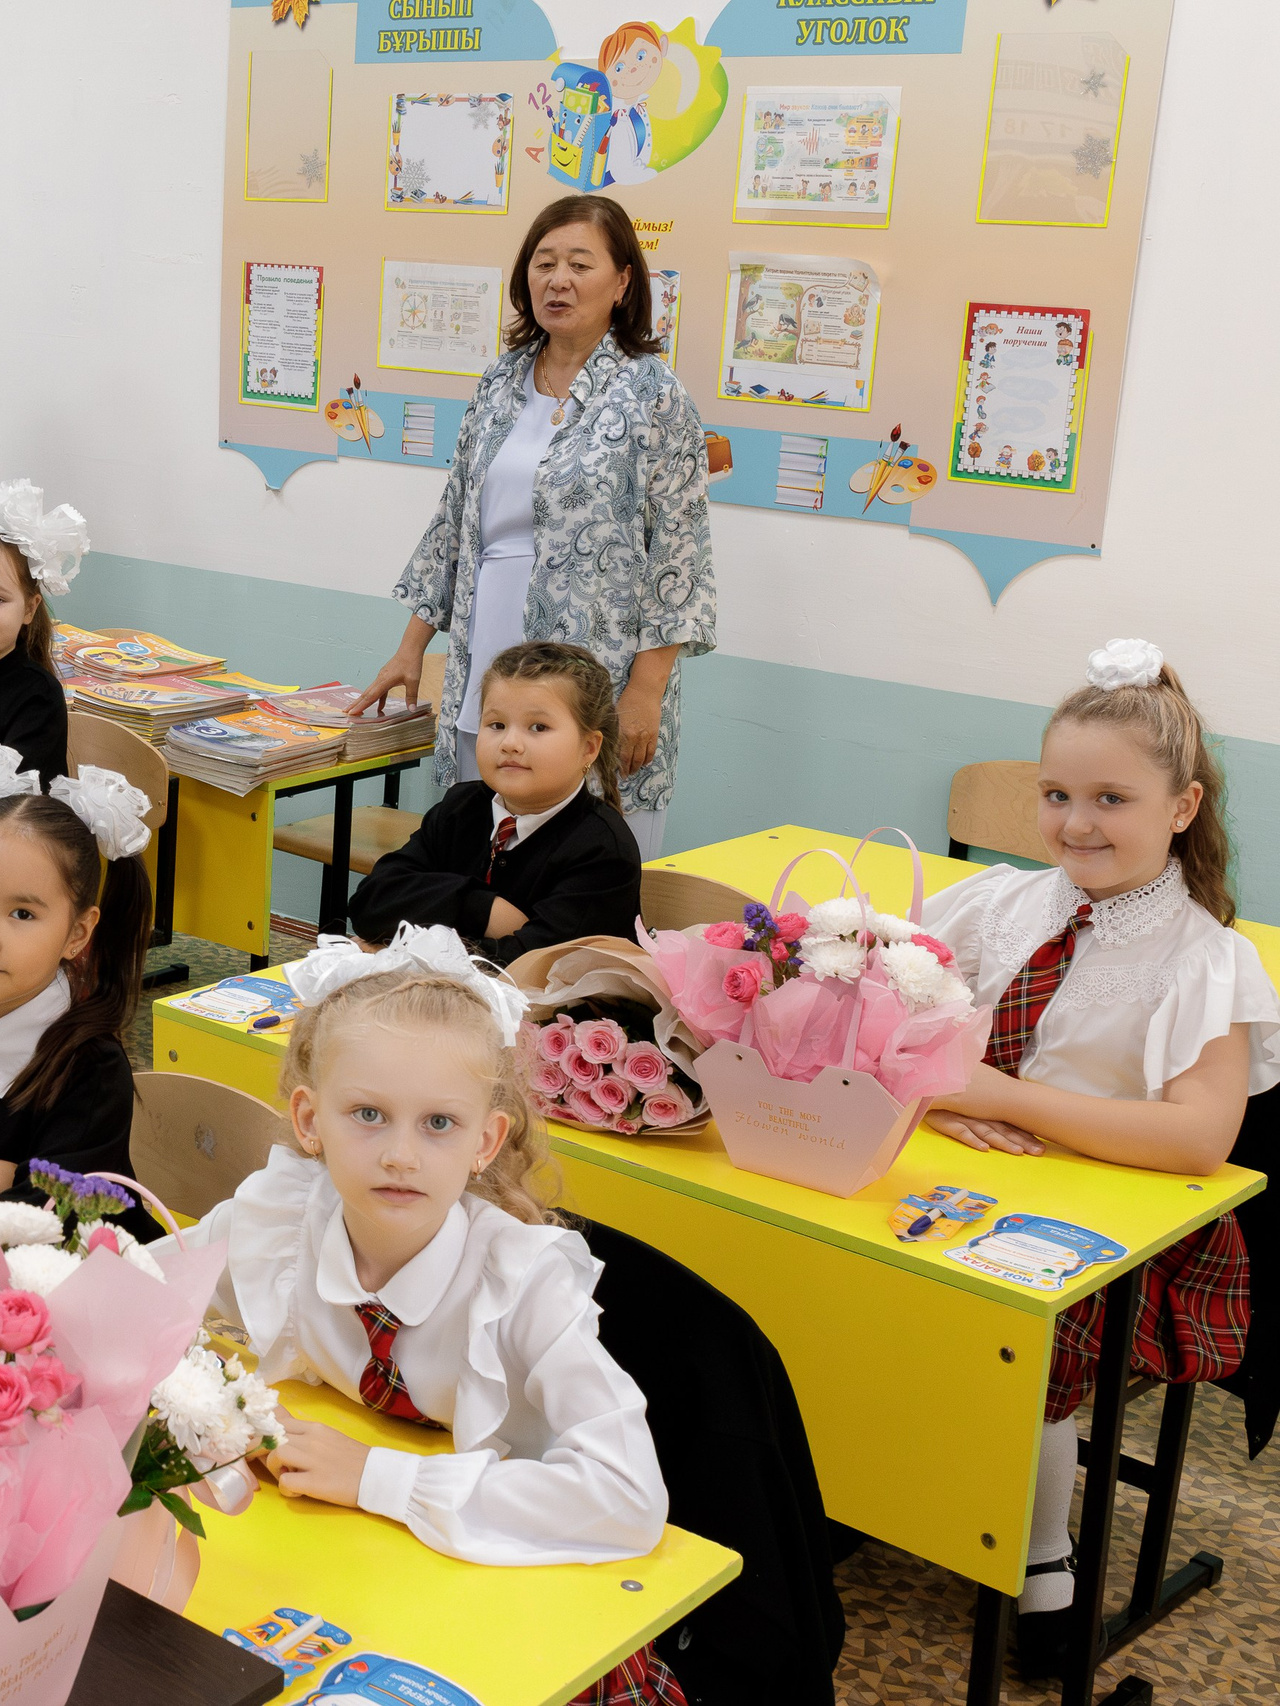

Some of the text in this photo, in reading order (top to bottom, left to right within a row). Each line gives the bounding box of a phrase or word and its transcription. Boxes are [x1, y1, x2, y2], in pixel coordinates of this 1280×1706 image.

[796, 16, 911, 46] УГОЛОК
[377, 27, 482, 53] БҰРЫШЫ
[257, 274, 314, 285] Правила поведения
[1016, 326, 1043, 336] Наши
[1002, 338, 1048, 348] поручения
[758, 1100, 822, 1123] YOU THE MOST
[768, 1114, 810, 1131] BEAUTIFUL
[959, 1255, 1002, 1273] БАГАЖ
[1003, 1271, 1034, 1284] МОЙ
